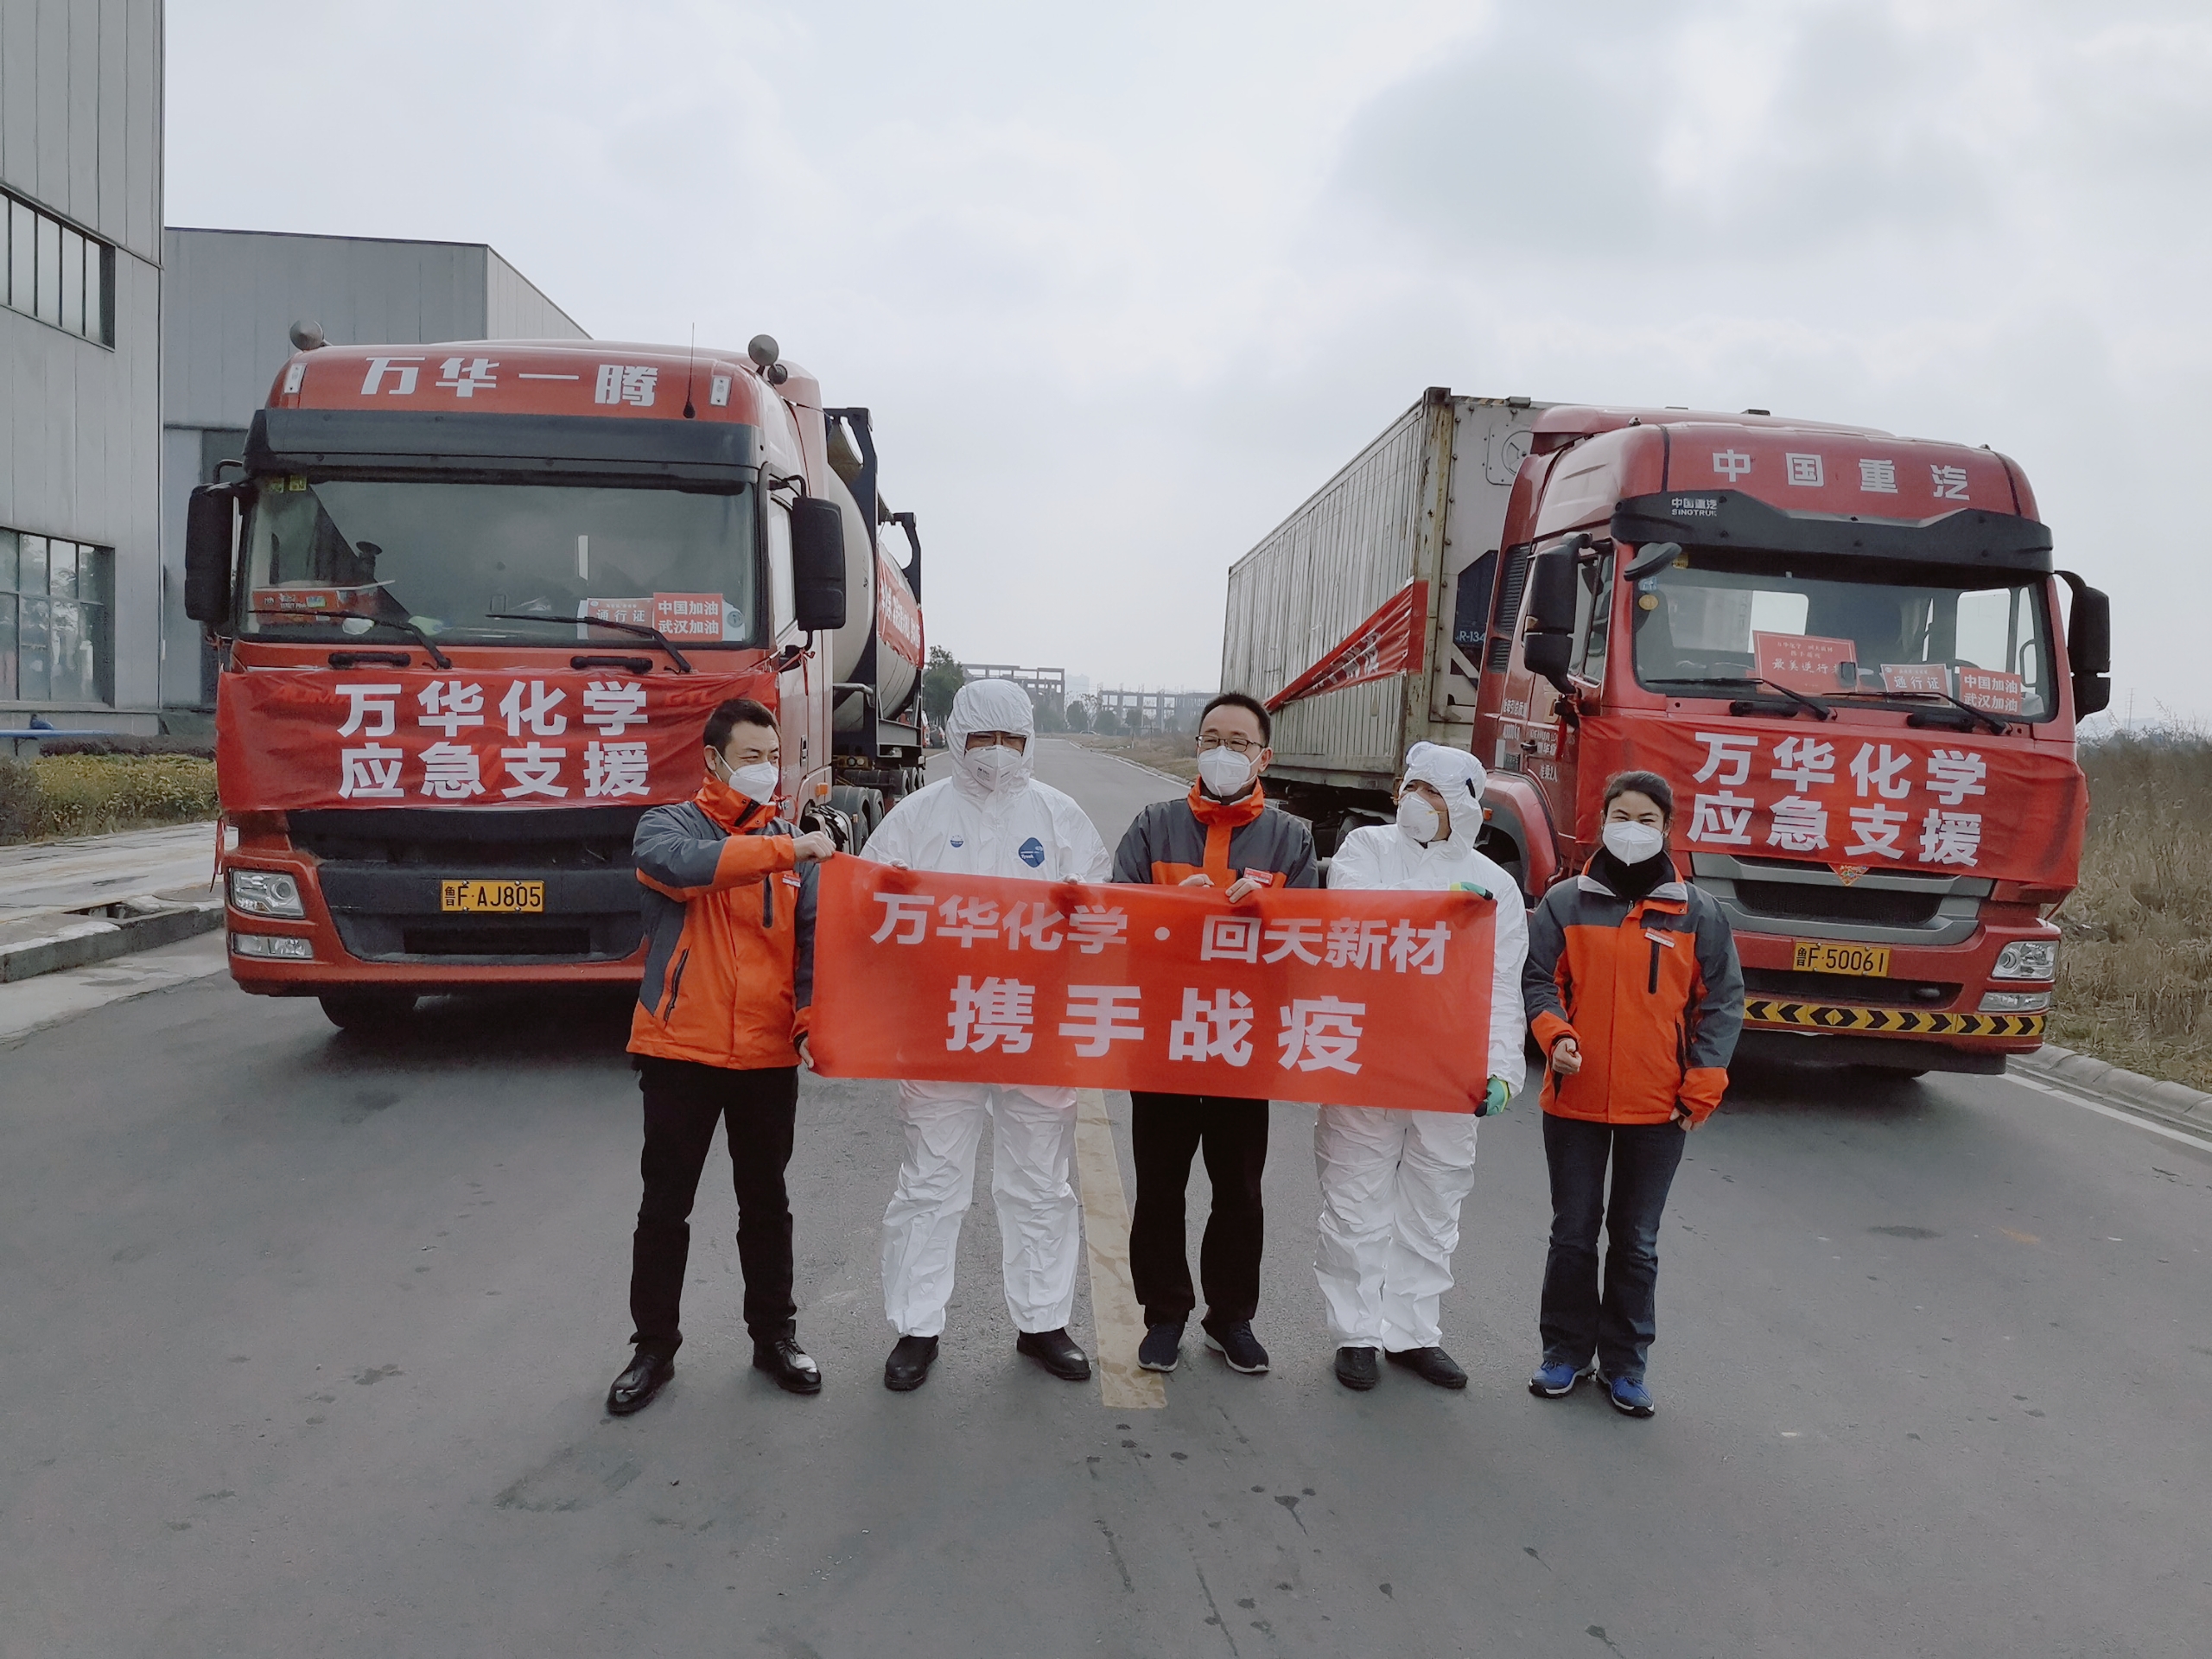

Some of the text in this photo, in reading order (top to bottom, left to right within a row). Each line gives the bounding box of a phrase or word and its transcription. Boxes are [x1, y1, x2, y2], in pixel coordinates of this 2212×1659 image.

[360, 356, 658, 407] 万华一腾
[1713, 449, 1970, 500] 中国重汽
[1671, 508, 1718, 517] SINOTRUK
[596, 609, 645, 623] 通行证
[658, 601, 719, 616] 中国加油
[658, 620, 719, 635] 武汉加油
[1893, 676, 1941, 690] 通行证
[1964, 675, 2018, 694] 中国加油
[335, 680, 648, 737] 万华化学
[1963, 692, 2018, 712] 武汉加油
[338, 741, 650, 798] 应急支援
[1693, 732, 1986, 805] 万华化学
[1687, 791, 1982, 867] 应急支援
[945, 975, 1366, 1076] 携手战疫
